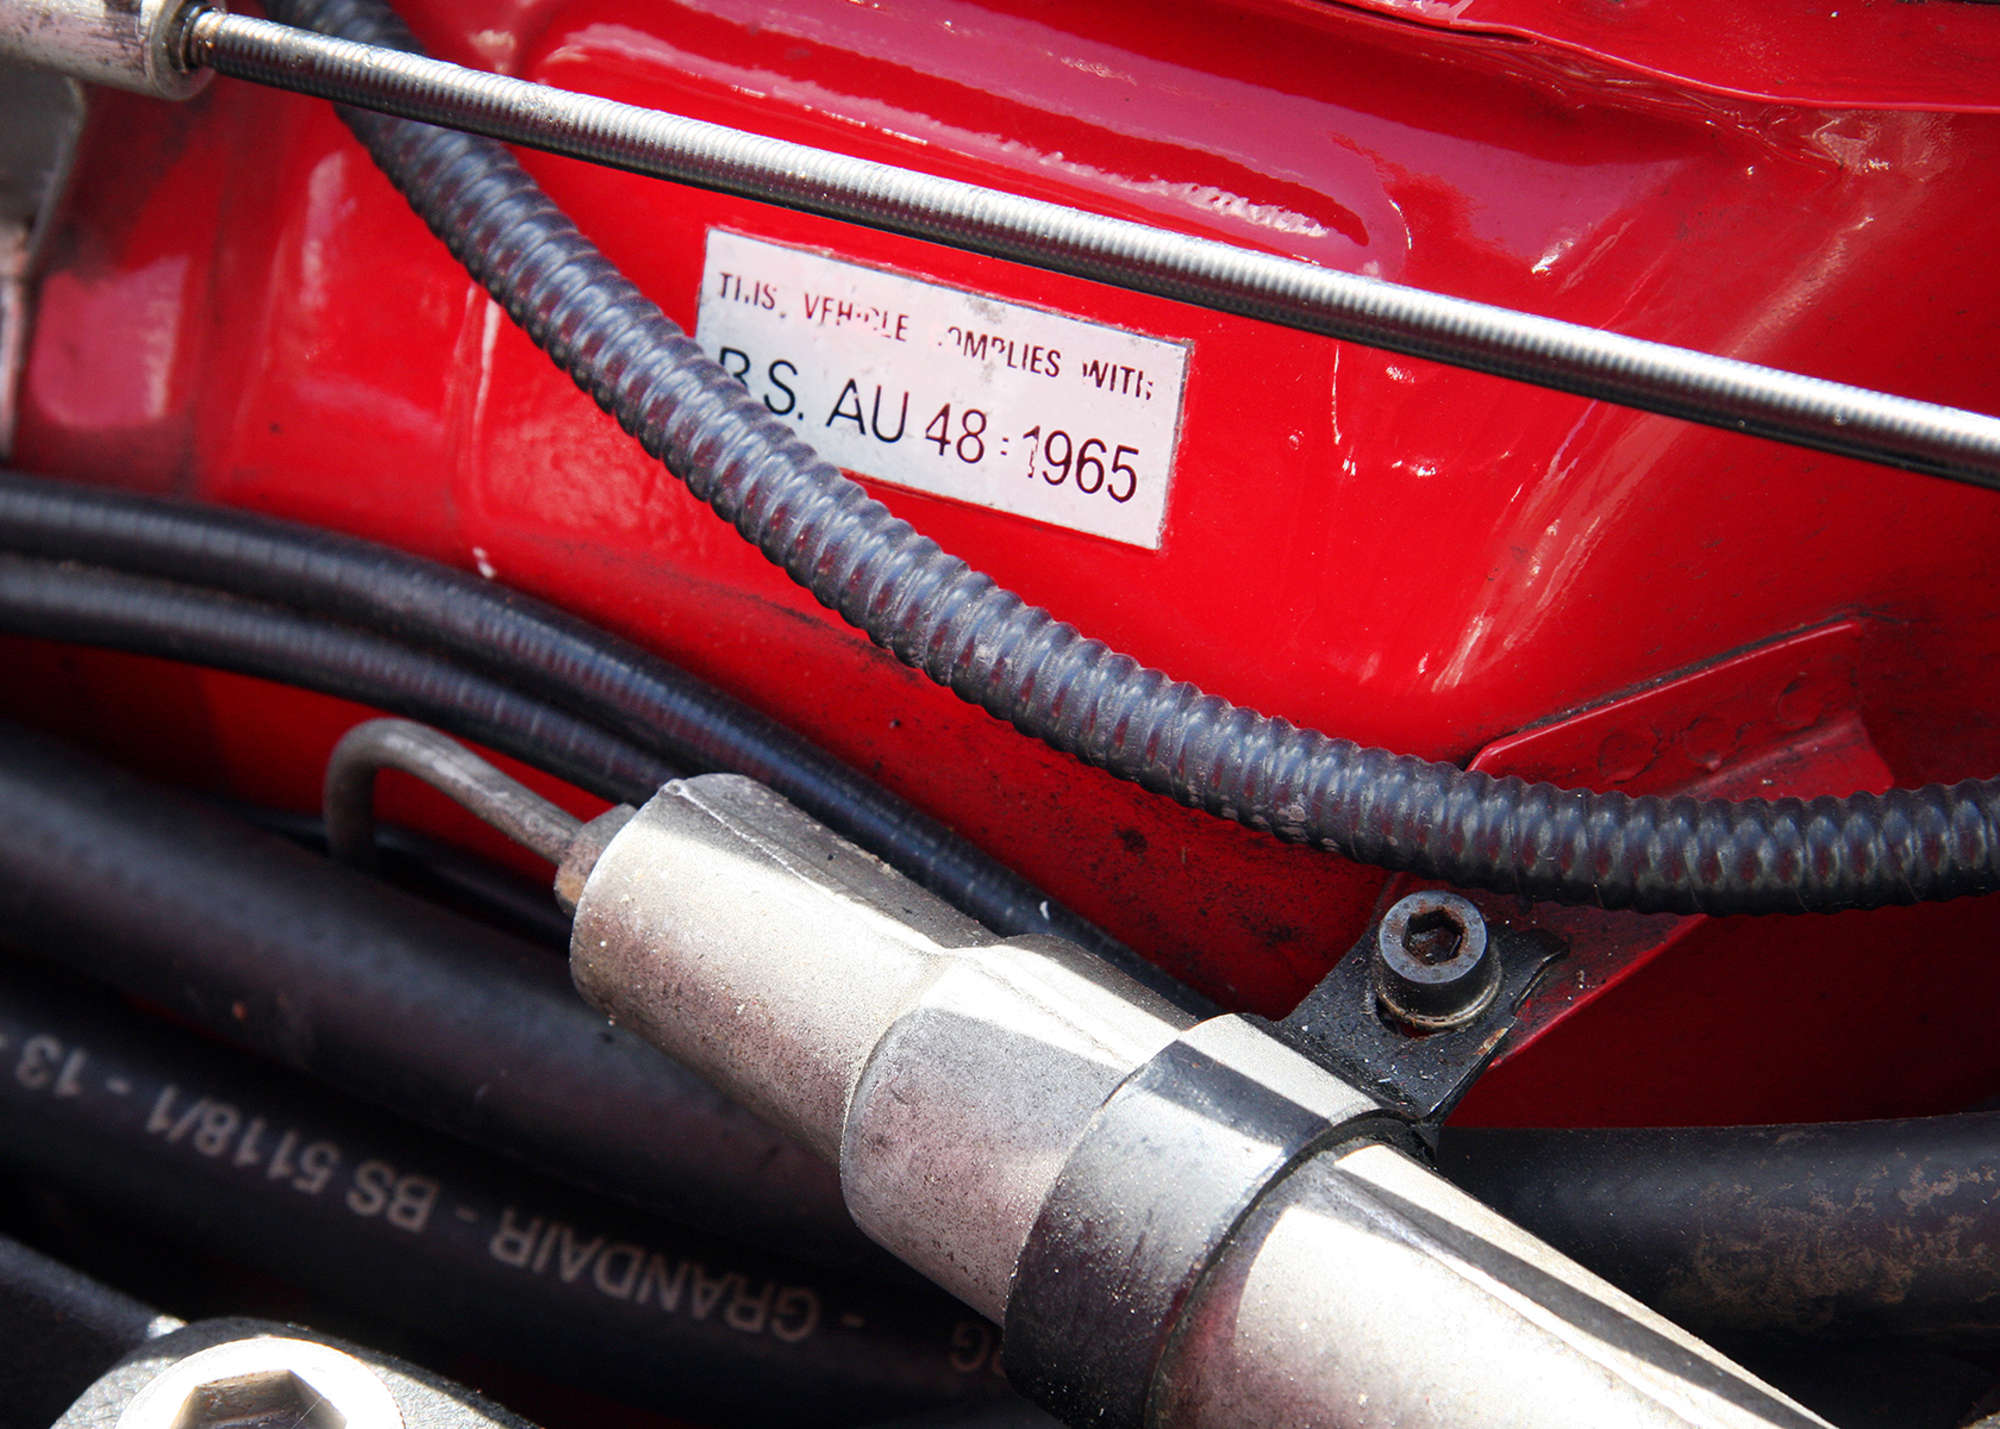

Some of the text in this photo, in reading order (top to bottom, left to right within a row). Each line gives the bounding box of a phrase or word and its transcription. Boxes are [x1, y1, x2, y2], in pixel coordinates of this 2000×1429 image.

[938, 326, 1061, 377] OMPLIES
[825, 378, 909, 443] AU
[15, 1034, 87, 1096] 13
[146, 1084, 341, 1194] 5118/1
[346, 1160, 441, 1234] BS
[489, 1207, 820, 1343] GRANDAIR
